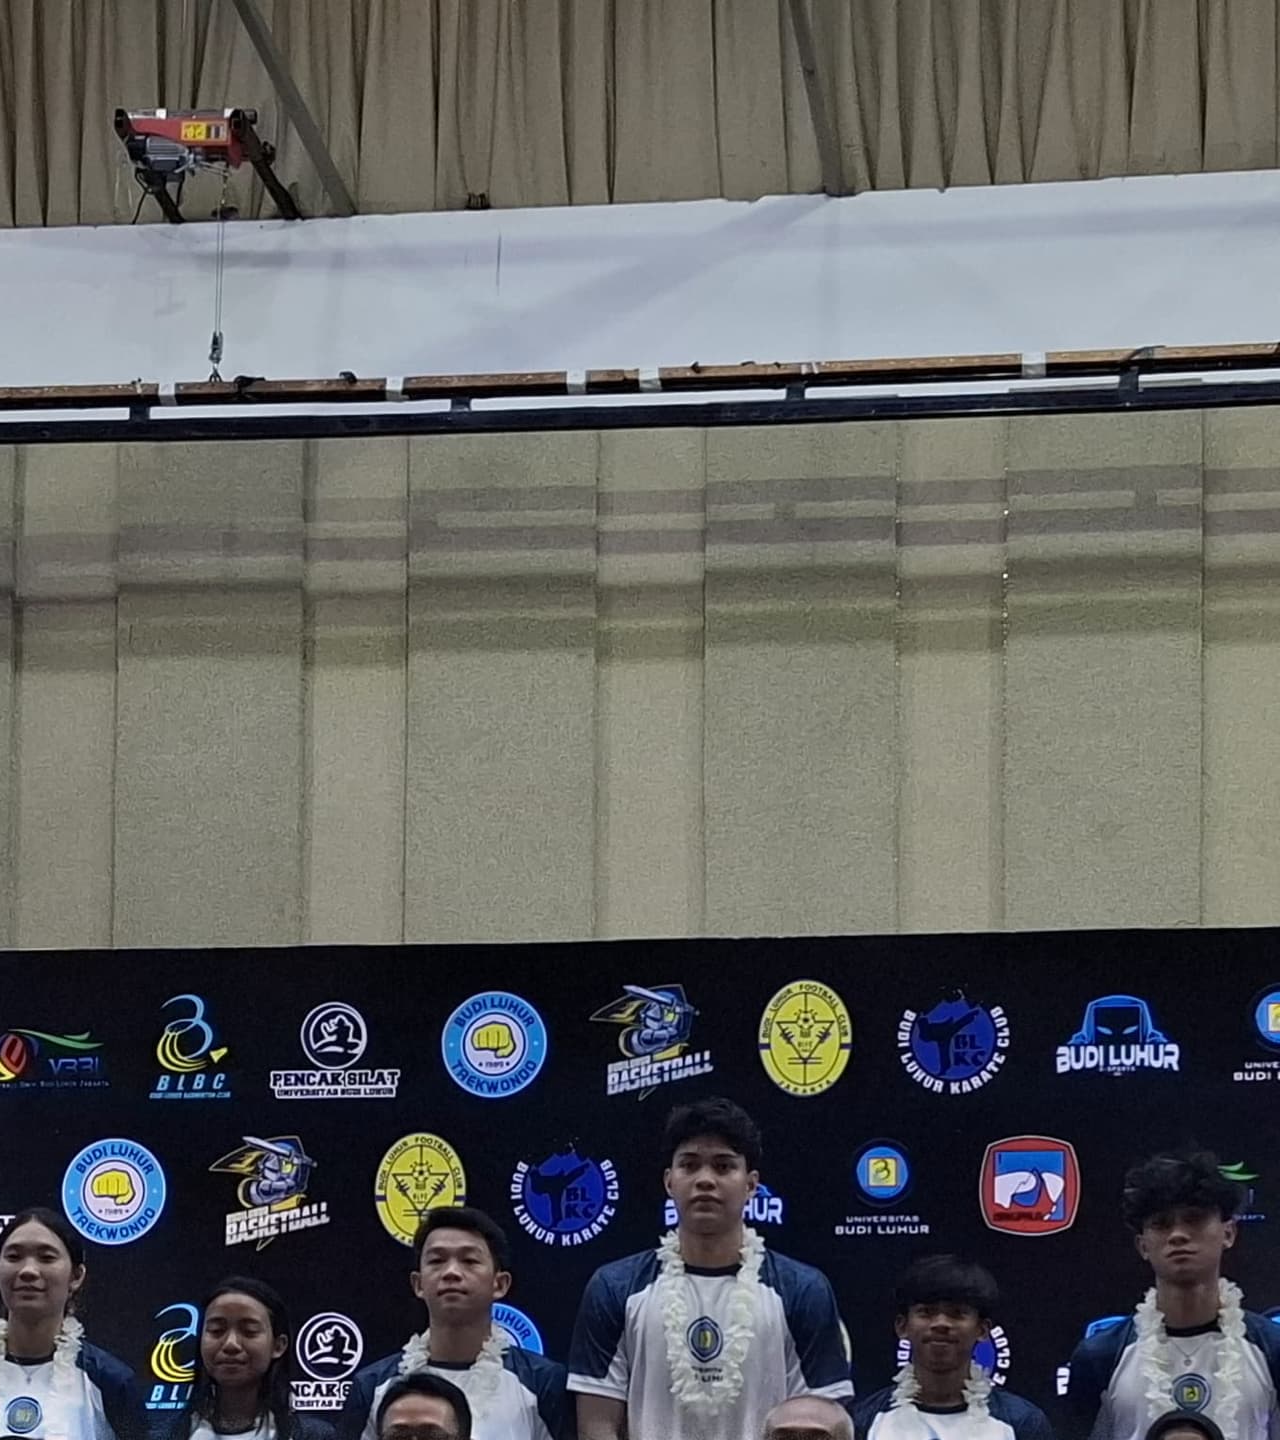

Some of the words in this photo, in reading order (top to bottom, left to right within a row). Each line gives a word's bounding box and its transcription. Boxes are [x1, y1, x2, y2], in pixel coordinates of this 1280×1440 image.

[454, 998, 487, 1027] BUDI
[490, 998, 535, 1027] LUHUR
[897, 1009, 917, 1047] BUDI
[990, 1005, 1010, 1048] CLUB
[607, 1050, 714, 1095] BASKETBALL
[900, 1052, 944, 1093] LUHUR
[950, 1052, 1006, 1095] KARATE
[1056, 1045, 1105, 1074] BUDI
[1109, 1043, 1180, 1072] LUHUR
[272, 1072, 343, 1087] PENCAK
[347, 1071, 399, 1086] SILAT
[277, 1088, 338, 1096] UNIVERSITAS
[452, 1060, 536, 1093] TAEKWONDO
[1233, 1071, 1272, 1081] BUDI
[75, 1146, 107, 1174] BUDI
[111, 1144, 154, 1175] LUHUR
[510, 1161, 529, 1200] BUDI
[600, 1159, 619, 1200] CLUB
[72, 1207, 155, 1239] TAEKWONDO
[225, 1203, 330, 1247] BASKETBALL
[513, 1204, 555, 1245] LUHUR
[561, 1205, 616, 1246] KARATE
[743, 1198, 783, 1224] HUR
[846, 1215, 919, 1223] UNIVERSITAS
[835, 1225, 872, 1235] BUDI
[877, 1224, 930, 1234] LUHUR
[494, 1309, 531, 1342] UHUR
[990, 1326, 1010, 1369] CLUB
